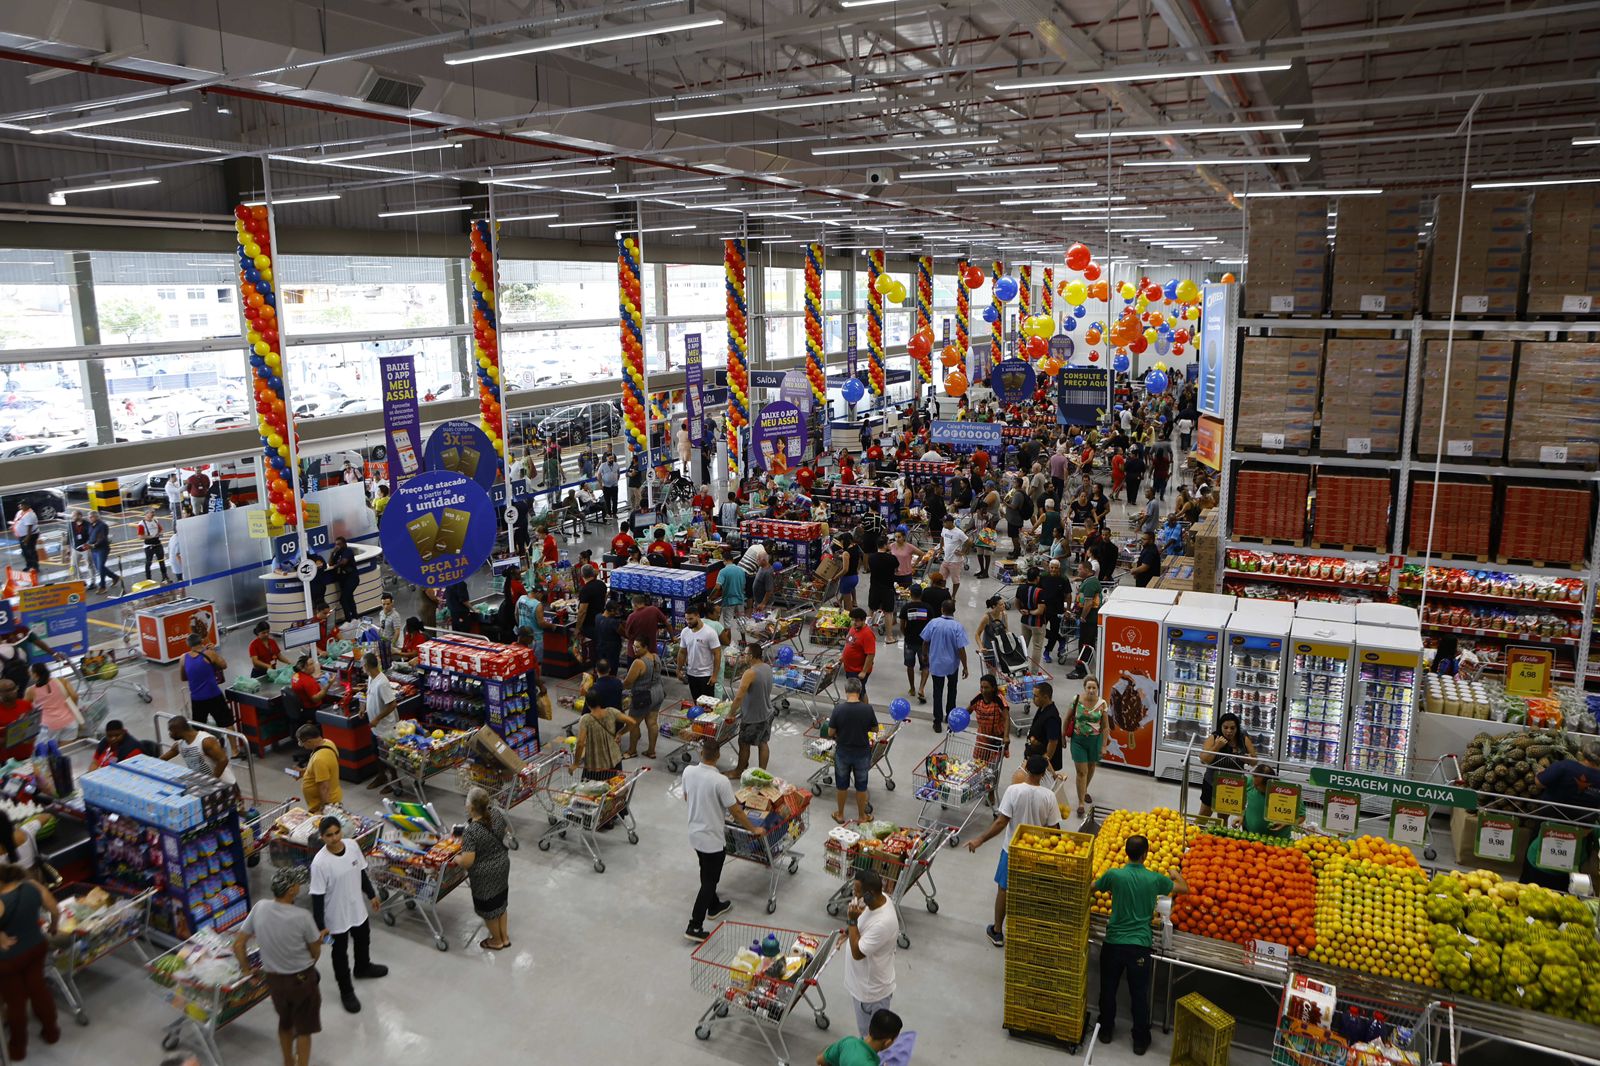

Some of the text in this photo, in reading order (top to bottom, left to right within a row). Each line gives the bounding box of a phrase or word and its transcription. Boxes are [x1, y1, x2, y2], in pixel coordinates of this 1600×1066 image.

[386, 362, 409, 372] BAIXE
[394, 371, 410, 379] APP
[389, 379, 410, 391] MEU
[386, 386, 415, 402] ASSAÍ
[703, 393, 715, 404] AÍDA
[761, 416, 798, 427] MEU ASSAÍ
[443, 432, 460, 445] 3x
[400, 486, 422, 495] Preço
[436, 477, 466, 488] atacado
[515, 485, 524, 496] 12
[424, 490, 441, 500] partir
[494, 491, 504, 501] 11
[405, 495, 465, 513] 1 unidade
[313, 534, 326, 547] 10
[281, 542, 296, 554] 09
[421, 555, 468, 575] PEÇA JÁ
[426, 569, 464, 584] O SEU!
[1112, 642, 1150, 656] Delicius
[1330, 774, 1454, 802] PESAGEM NO CAIXA
[1334, 813, 1350, 821] 9,99
[1402, 824, 1418, 833] 9,99
[1489, 838, 1504, 846] 9,98
[1550, 848, 1567, 857] 9,98
